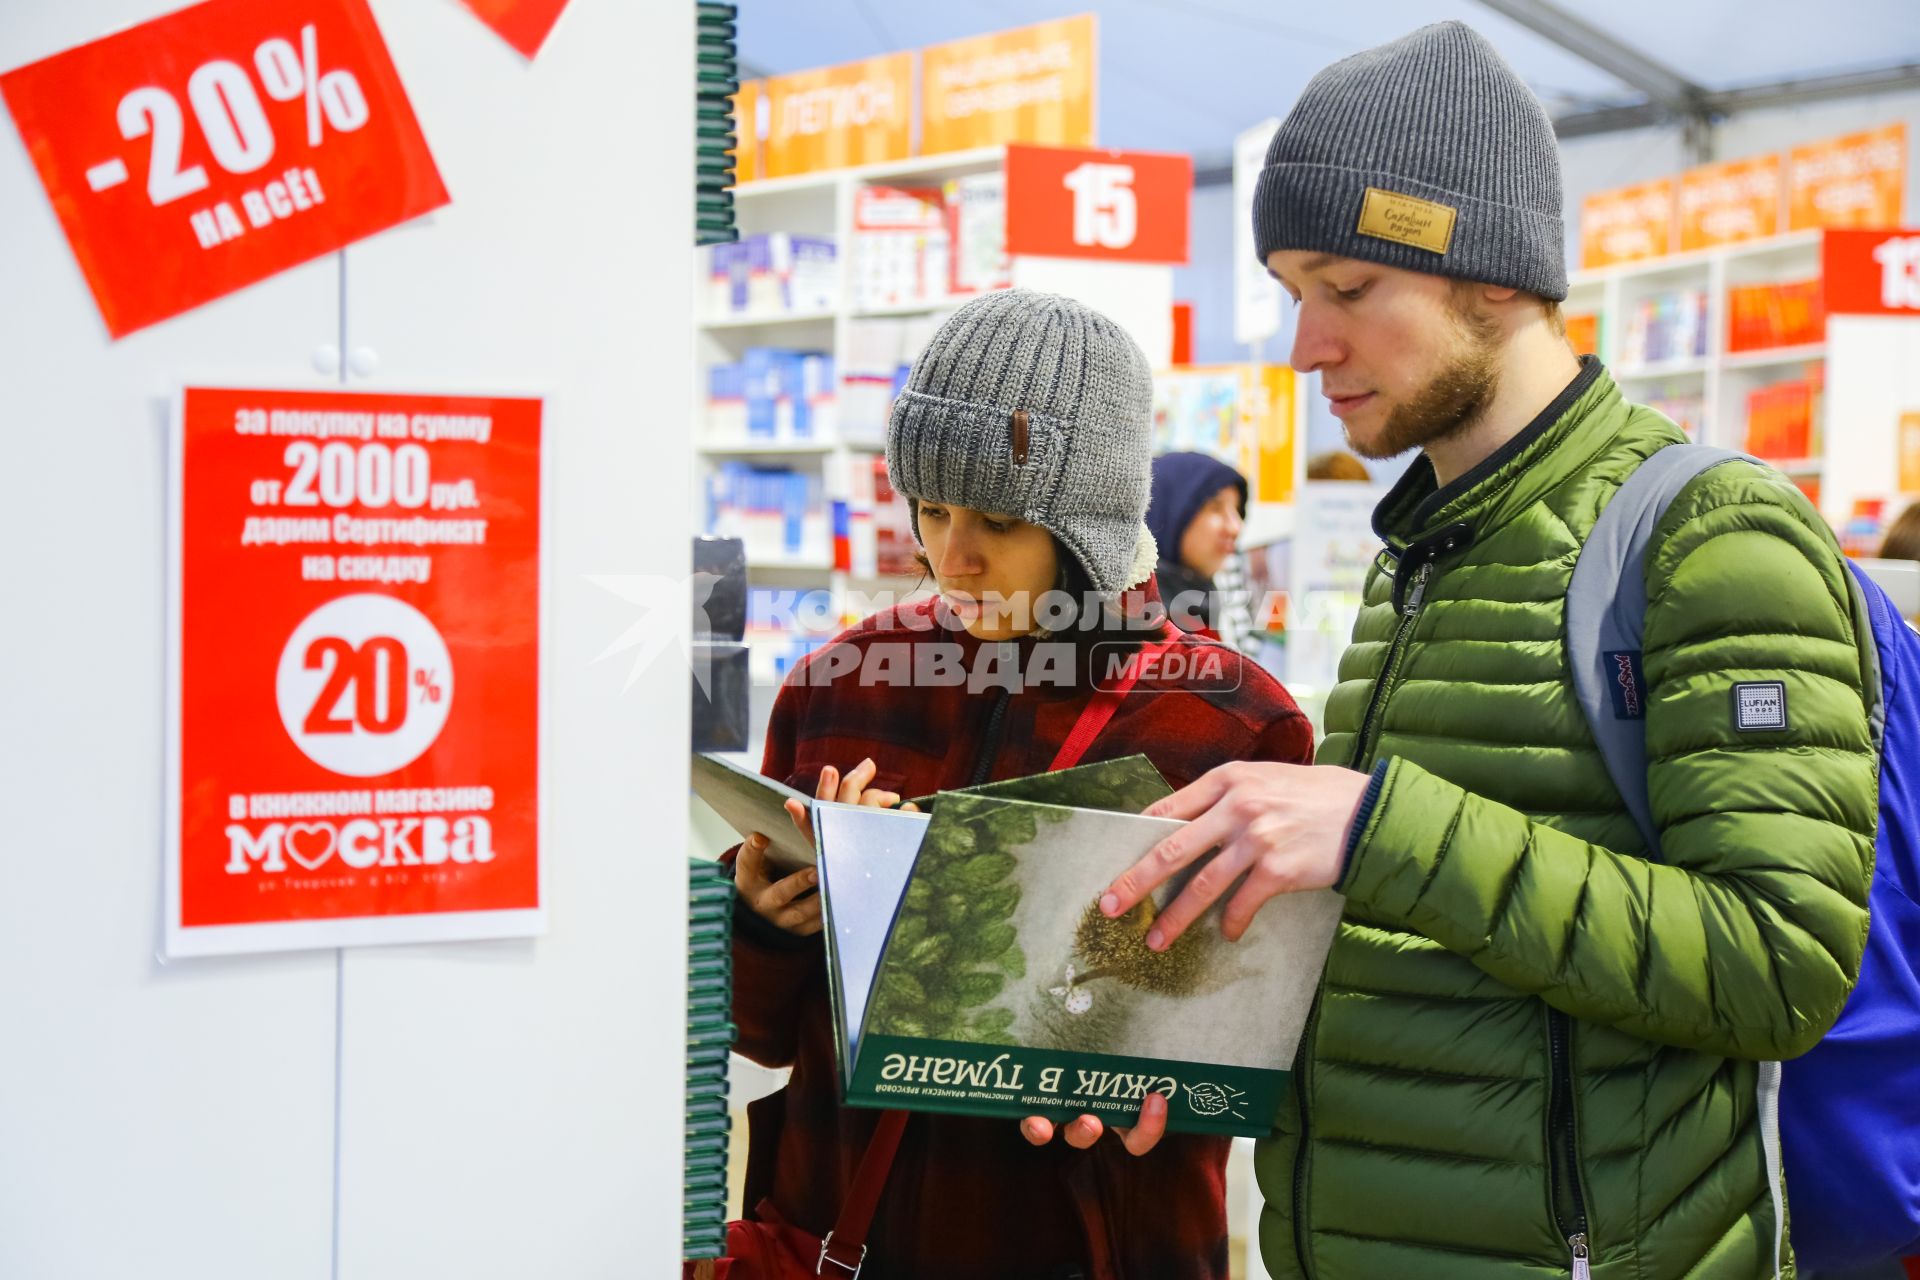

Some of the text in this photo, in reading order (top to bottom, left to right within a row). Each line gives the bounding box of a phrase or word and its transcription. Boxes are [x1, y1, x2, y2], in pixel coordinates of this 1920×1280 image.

[85, 23, 371, 207] -20%
[189, 166, 326, 250] НА ВСЁ!
[1062, 161, 1138, 249] 15
[234, 408, 493, 443] за покупку на сумму
[250, 440, 481, 511] от 2000 руб.
[241, 513, 488, 546] дарим Сертификат
[301, 554, 432, 584] на скидку
[1744, 699, 1777, 707] LUFIAN
[249, 789, 372, 819] книжном
[374, 785, 494, 815] магазине
[875, 1083, 920, 1095] ЯРБУСОВОЙ
[921, 1086, 966, 1098] ФРАНЧЕСКИ
[1021, 1095, 1063, 1106] НОРШТЕЙН
[1064, 1099, 1088, 1108] ЮРИЙ
[1092, 1101, 1121, 1111] КОЗЛОВ
